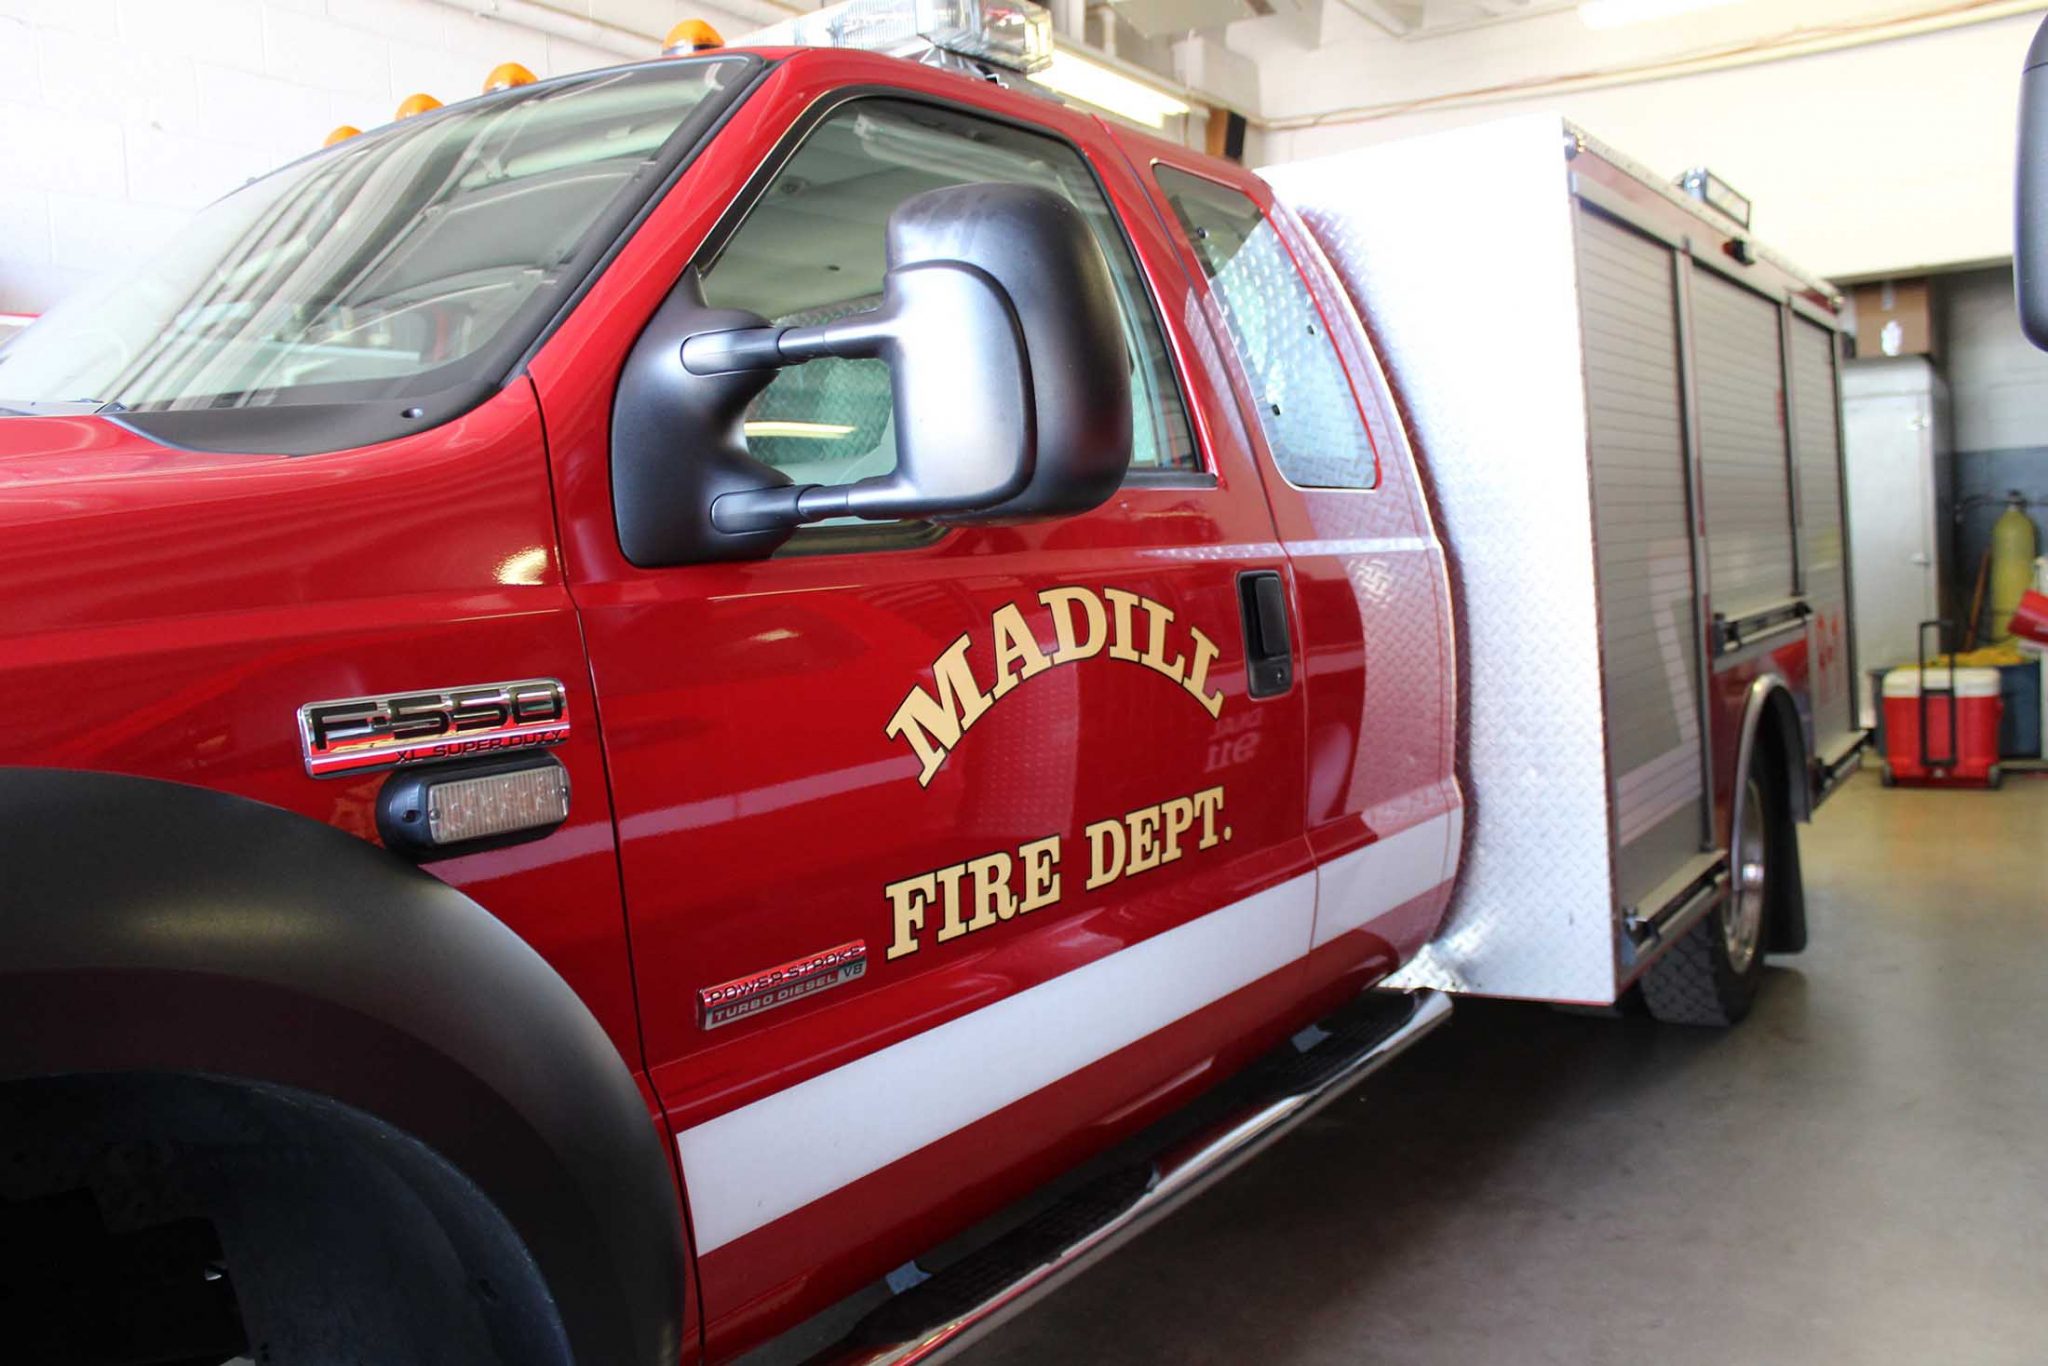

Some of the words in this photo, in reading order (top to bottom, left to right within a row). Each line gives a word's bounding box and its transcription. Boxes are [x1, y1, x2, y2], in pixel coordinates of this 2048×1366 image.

[884, 585, 1225, 788] MADILL
[397, 749, 423, 763] XL
[433, 738, 502, 758] SUPER
[510, 729, 563, 746] DUTY
[884, 835, 1061, 961] FIRE
[1085, 786, 1233, 891] DEPT.
[710, 972, 784, 1003] POWER
[788, 945, 863, 978] STROKE
[714, 993, 774, 1021] TURBO
[777, 973, 837, 1001] DIESEL
[843, 962, 864, 978] V8
